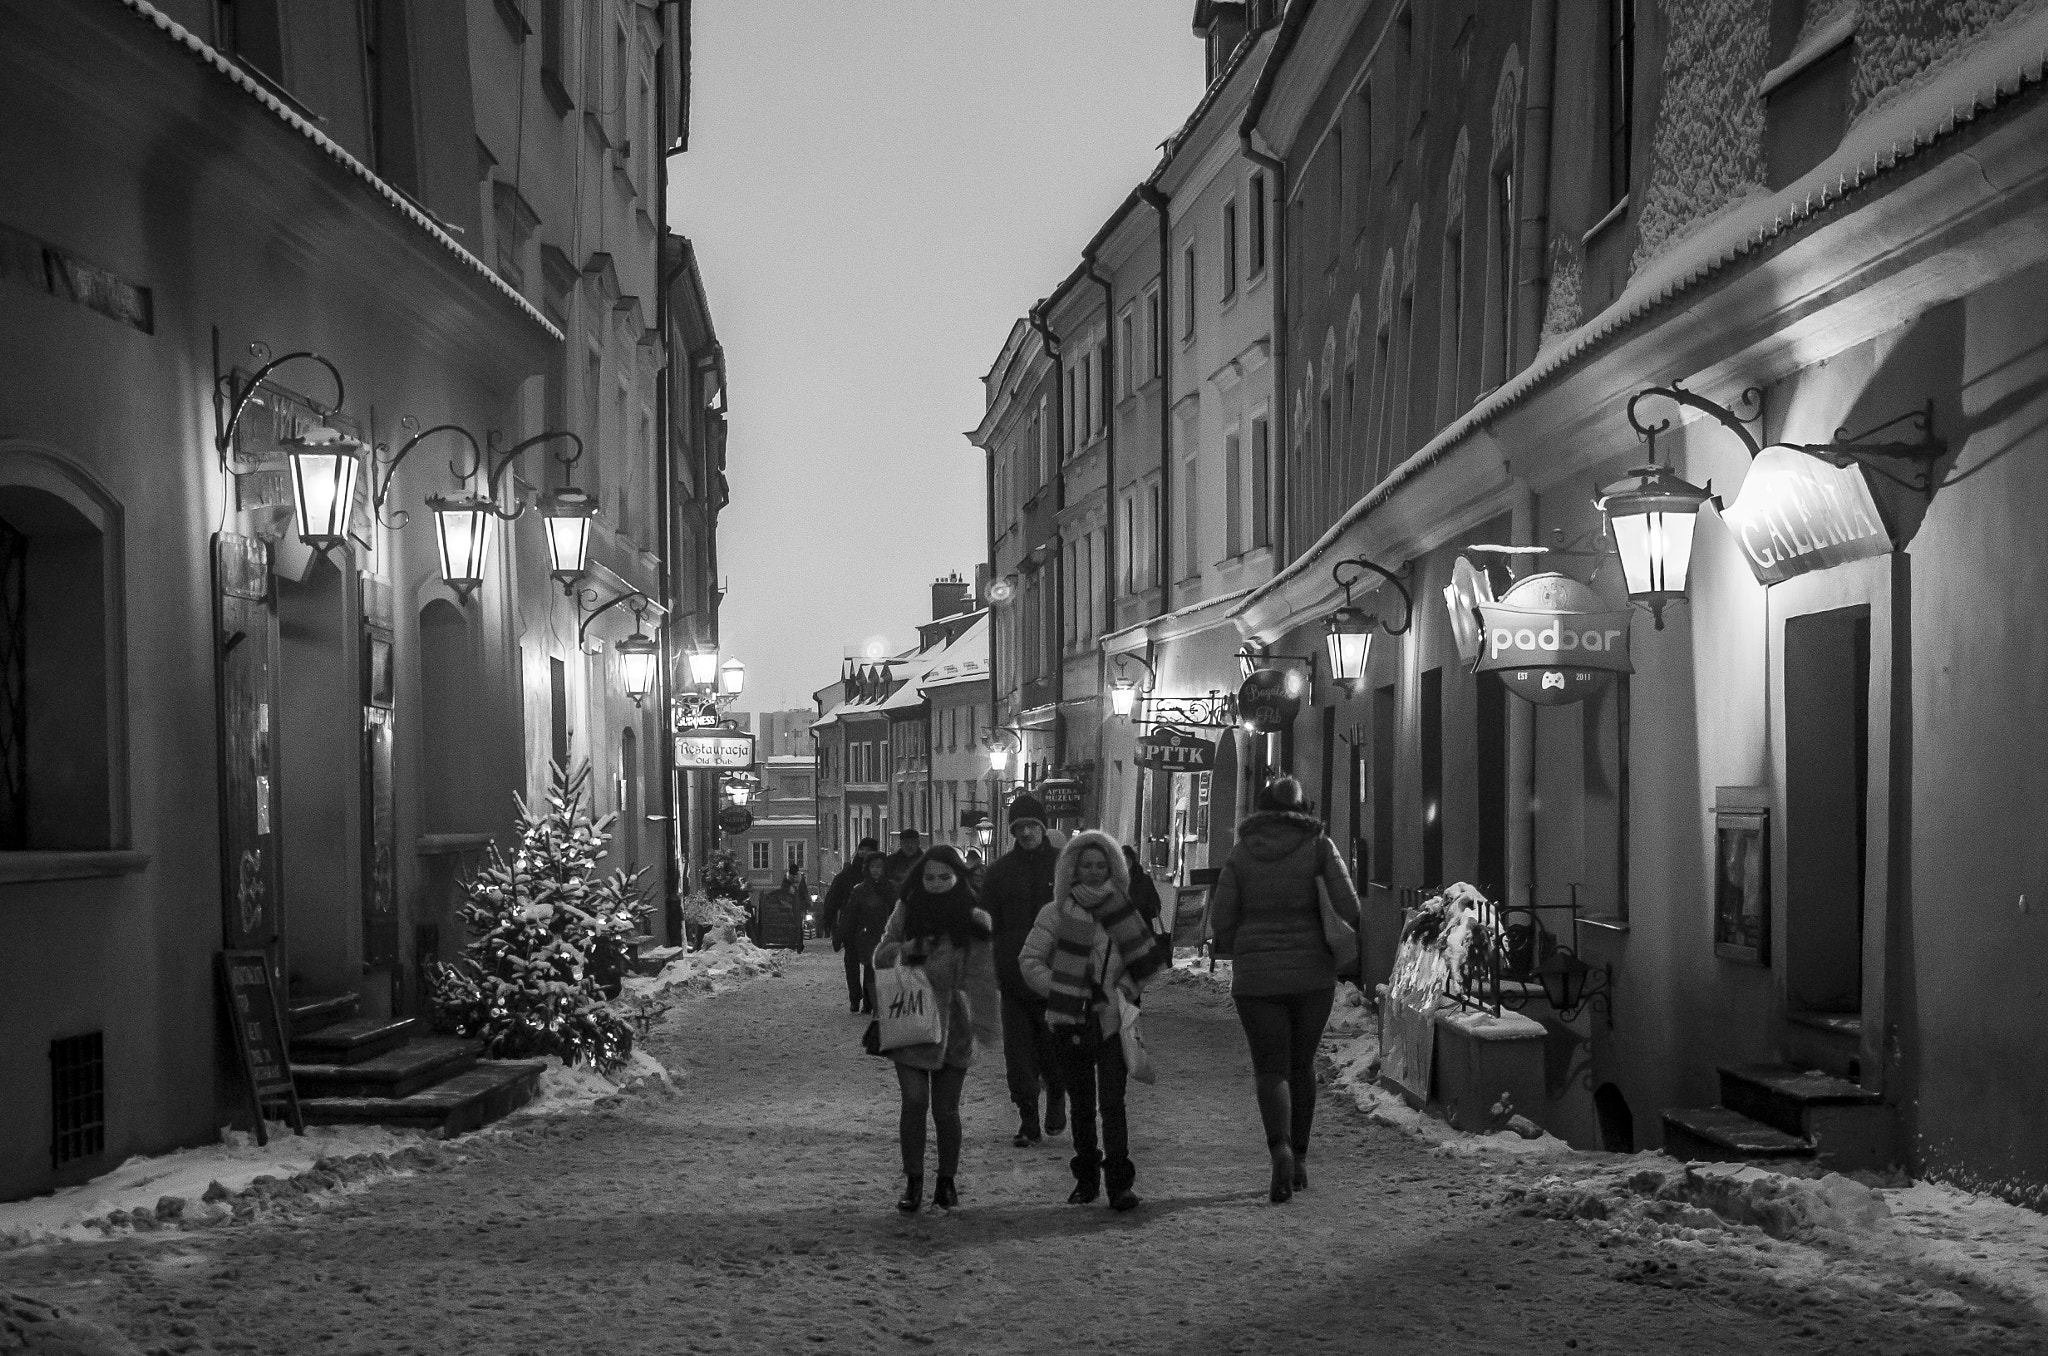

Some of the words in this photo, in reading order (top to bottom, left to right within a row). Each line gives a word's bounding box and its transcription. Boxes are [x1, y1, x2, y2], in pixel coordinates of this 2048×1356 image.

[1741, 472, 1878, 568] GALERIA
[1491, 619, 1621, 660] padbar
[1517, 672, 1528, 681] EST
[1255, 705, 1282, 724] Pub
[680, 741, 749, 758] Restauracja
[1145, 744, 1204, 764] PTTK
[695, 757, 710, 765] Old
[714, 757, 733, 766] Pub
[1045, 794, 1081, 802] MUZEUM
